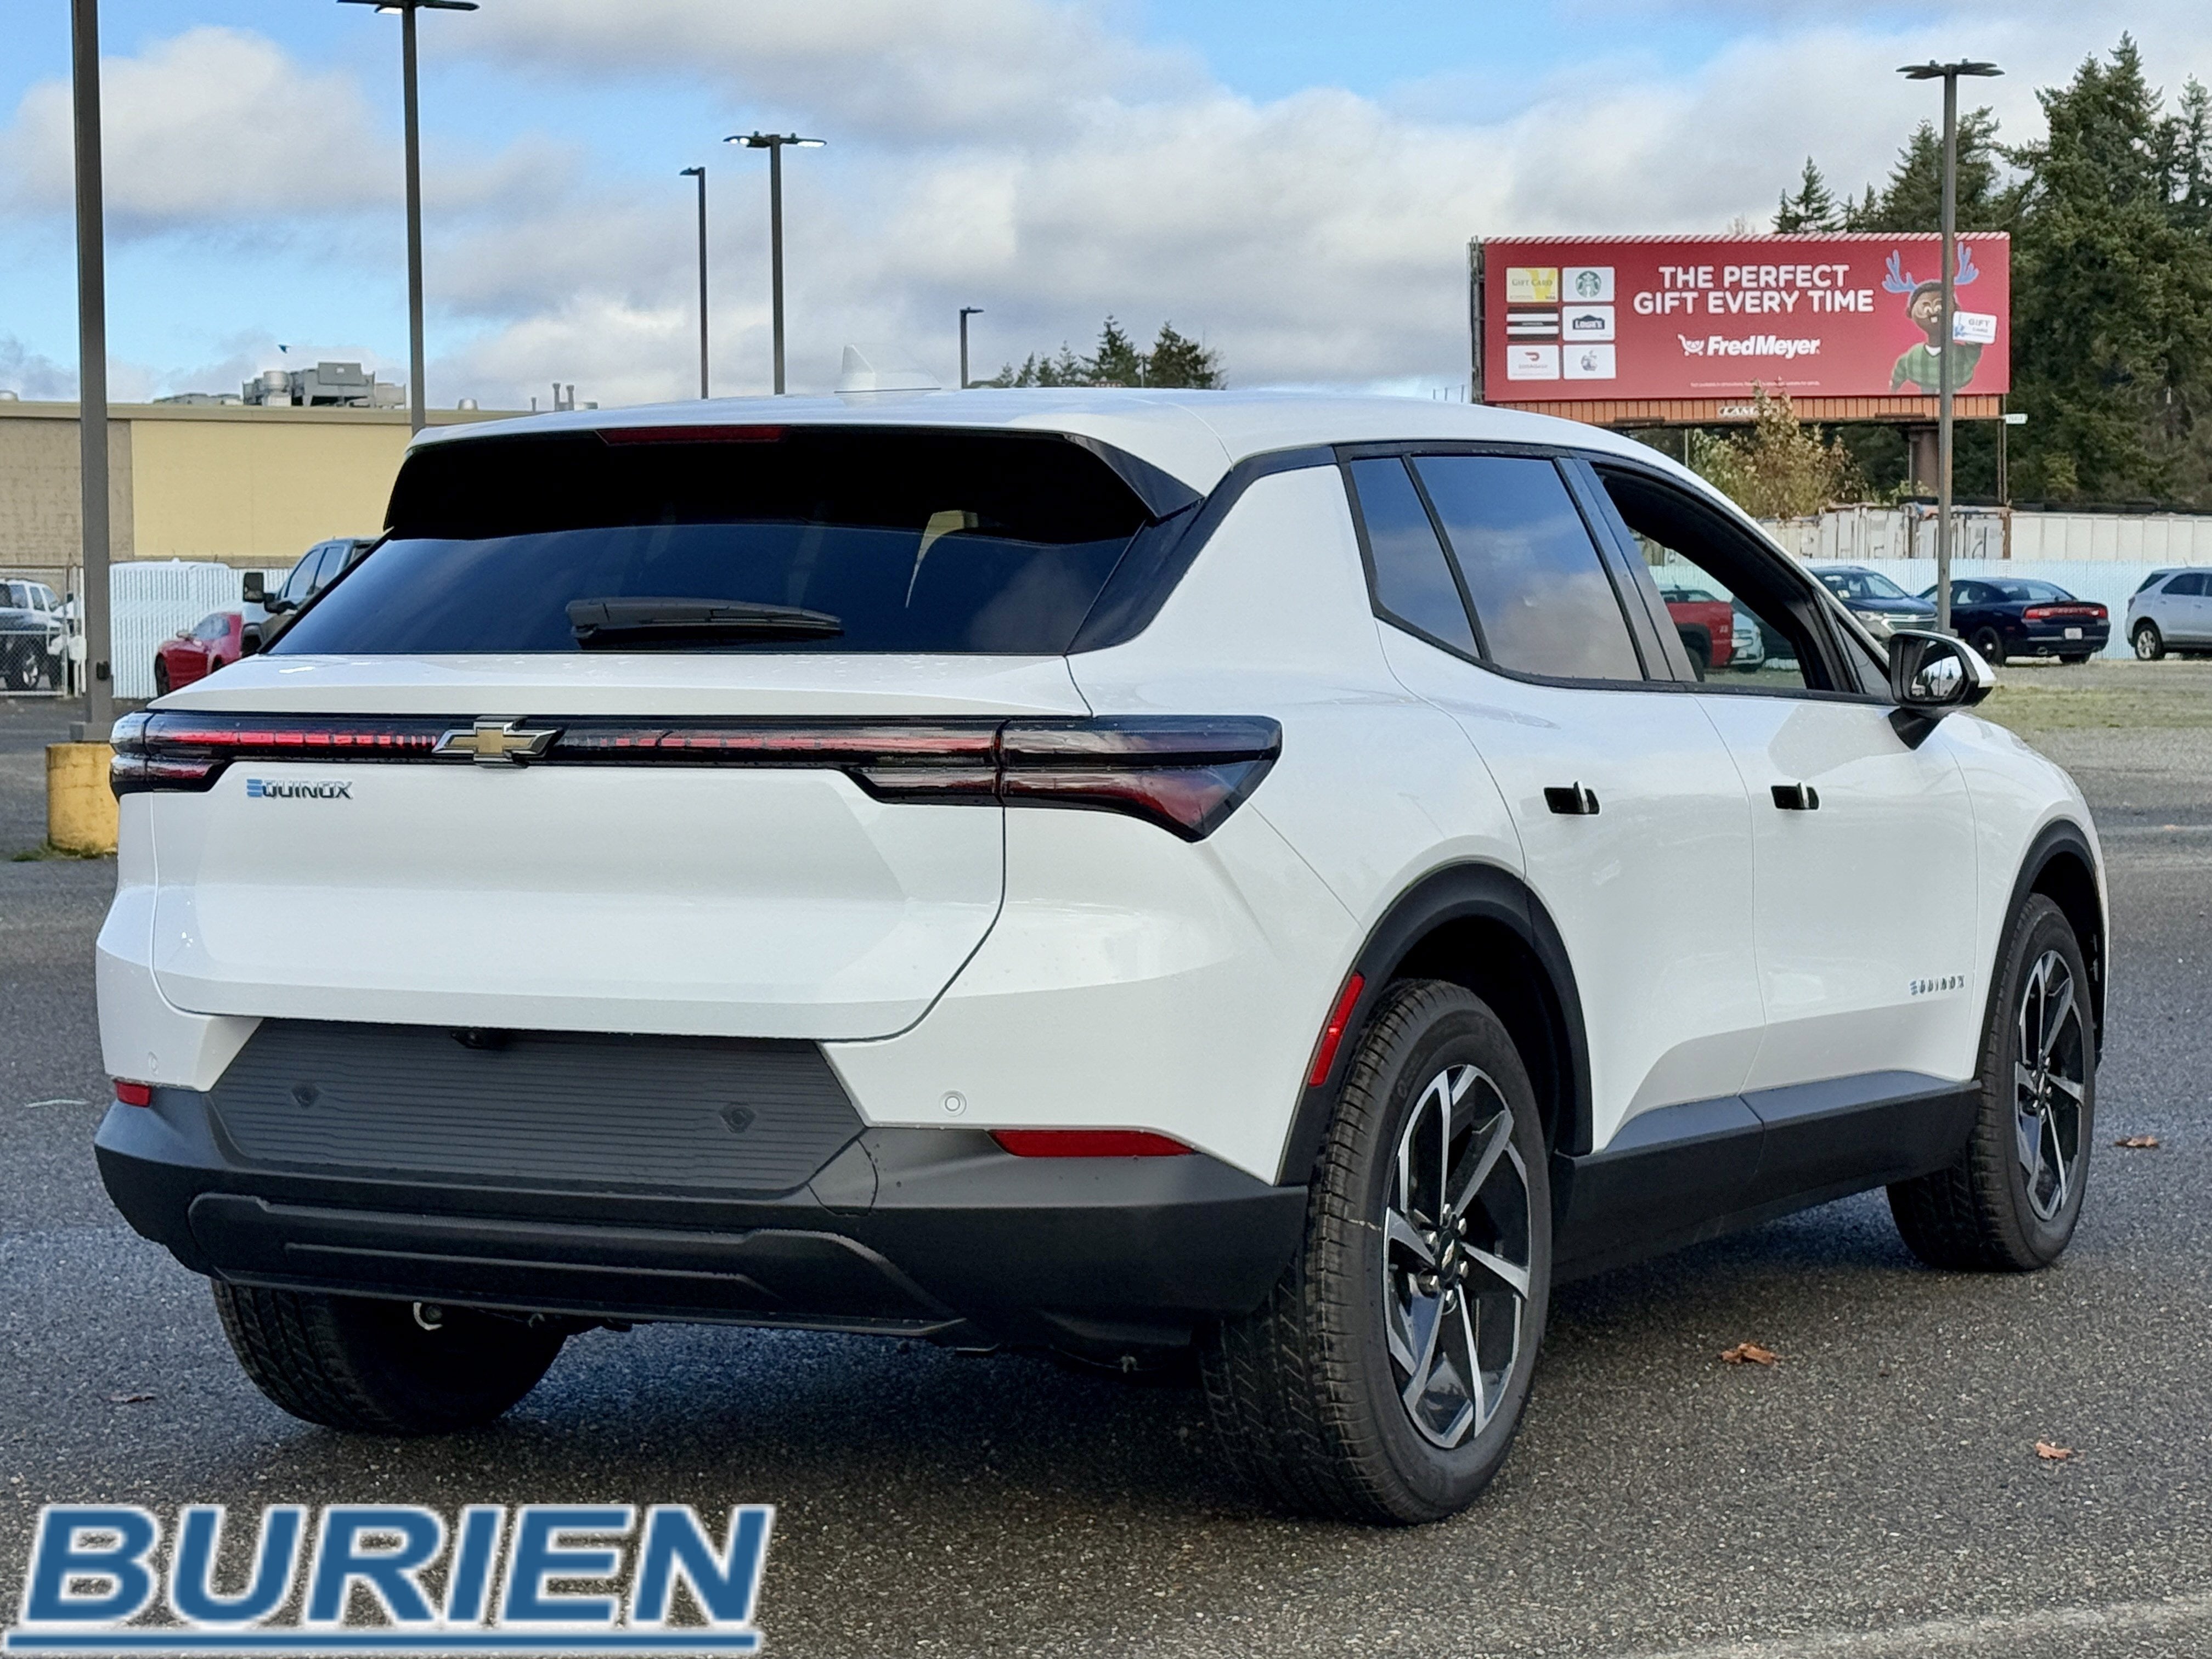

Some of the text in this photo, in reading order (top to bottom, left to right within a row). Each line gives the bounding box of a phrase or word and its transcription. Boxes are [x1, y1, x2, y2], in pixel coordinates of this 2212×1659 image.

[1658, 264, 1849, 289] THE PERFECT
[1634, 289, 1874, 314] GIFT EVERY TIME
[1968, 318, 1990, 327] GIFT
[247, 779, 353, 800] EQUINOX
